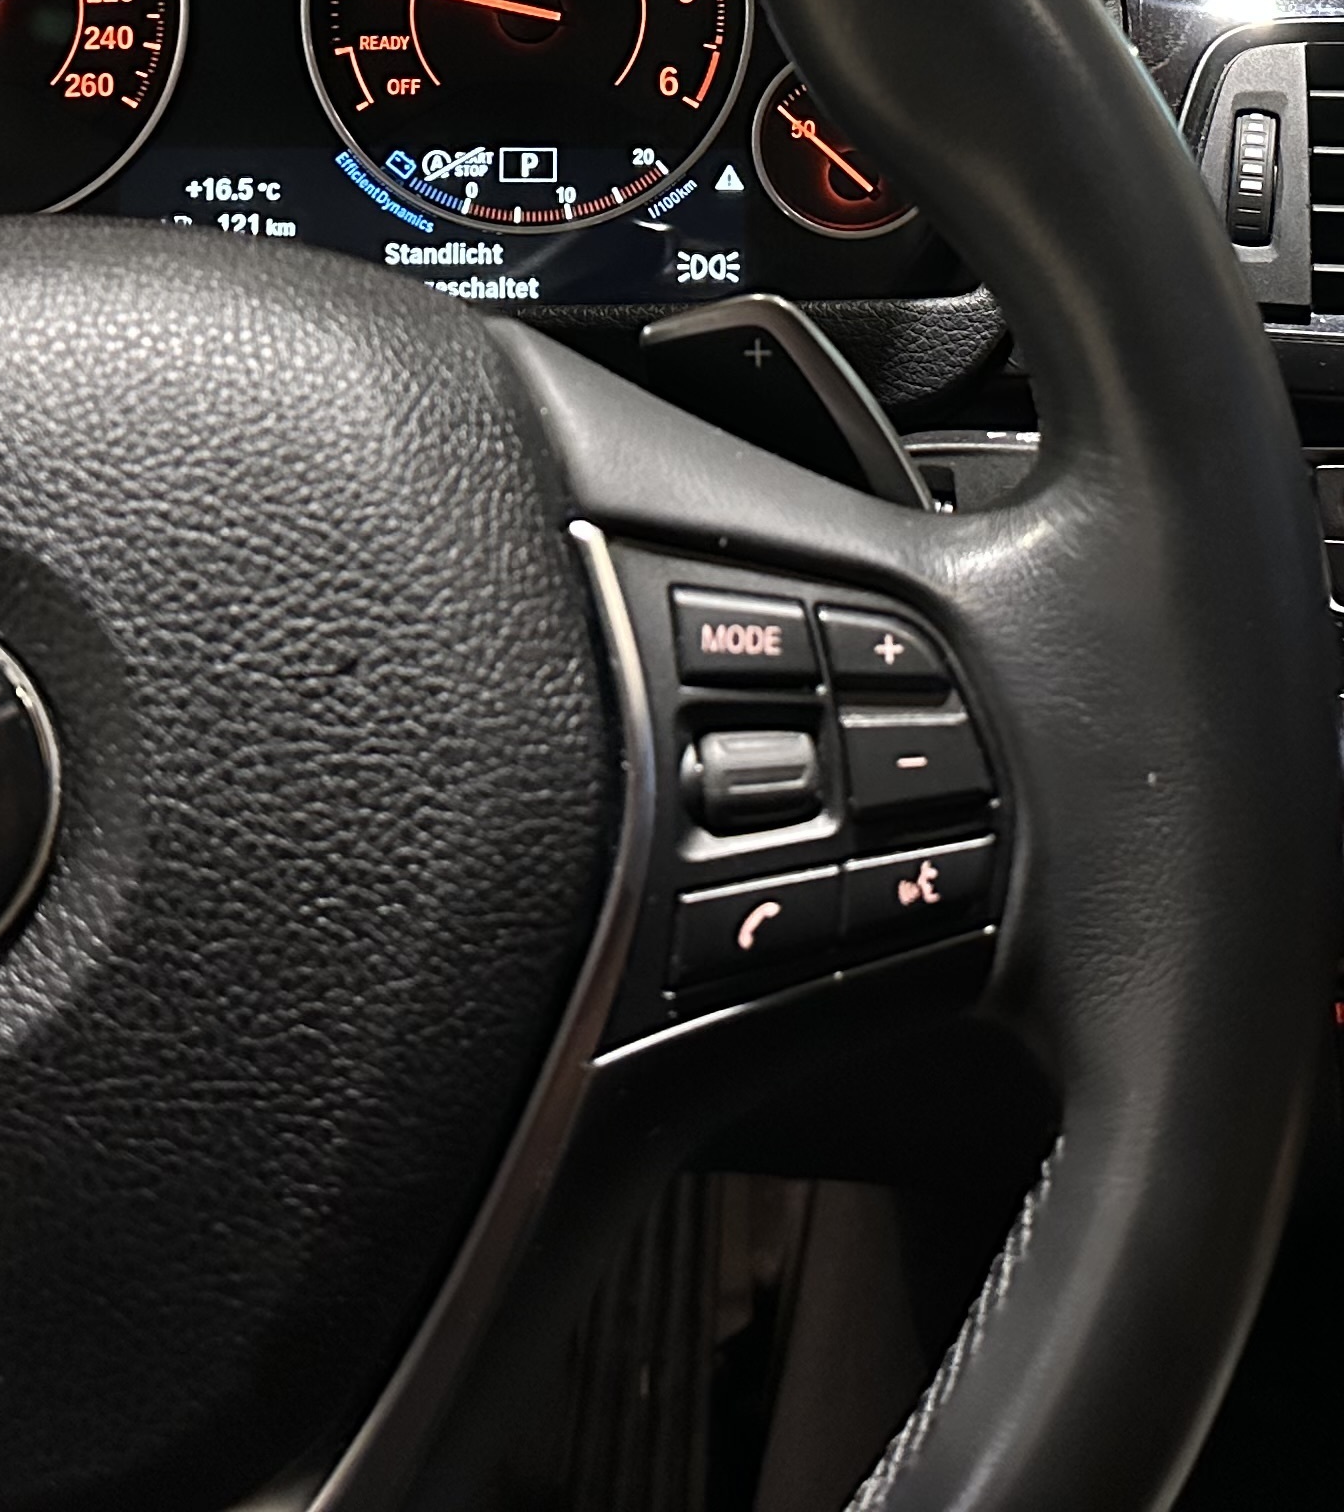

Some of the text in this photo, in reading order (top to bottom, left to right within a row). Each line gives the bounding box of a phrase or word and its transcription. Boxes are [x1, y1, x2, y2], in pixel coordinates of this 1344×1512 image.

[84, 26, 134, 50] 240
[360, 35, 410, 51] READY
[64, 73, 114, 97] 260
[387, 79, 421, 95] OFF
[659, 67, 678, 96] 6
[521, 152, 539, 178] P
[632, 148, 655, 165] 20
[185, 177, 254, 201] +16.5
[335, 151, 435, 234] EfficientDynamics
[465, 181, 479, 199] 0
[556, 186, 577, 204] 10
[217, 213, 296, 237] 121 km
[384, 242, 504, 265] Standlicht
[701, 625, 781, 655] MODE
